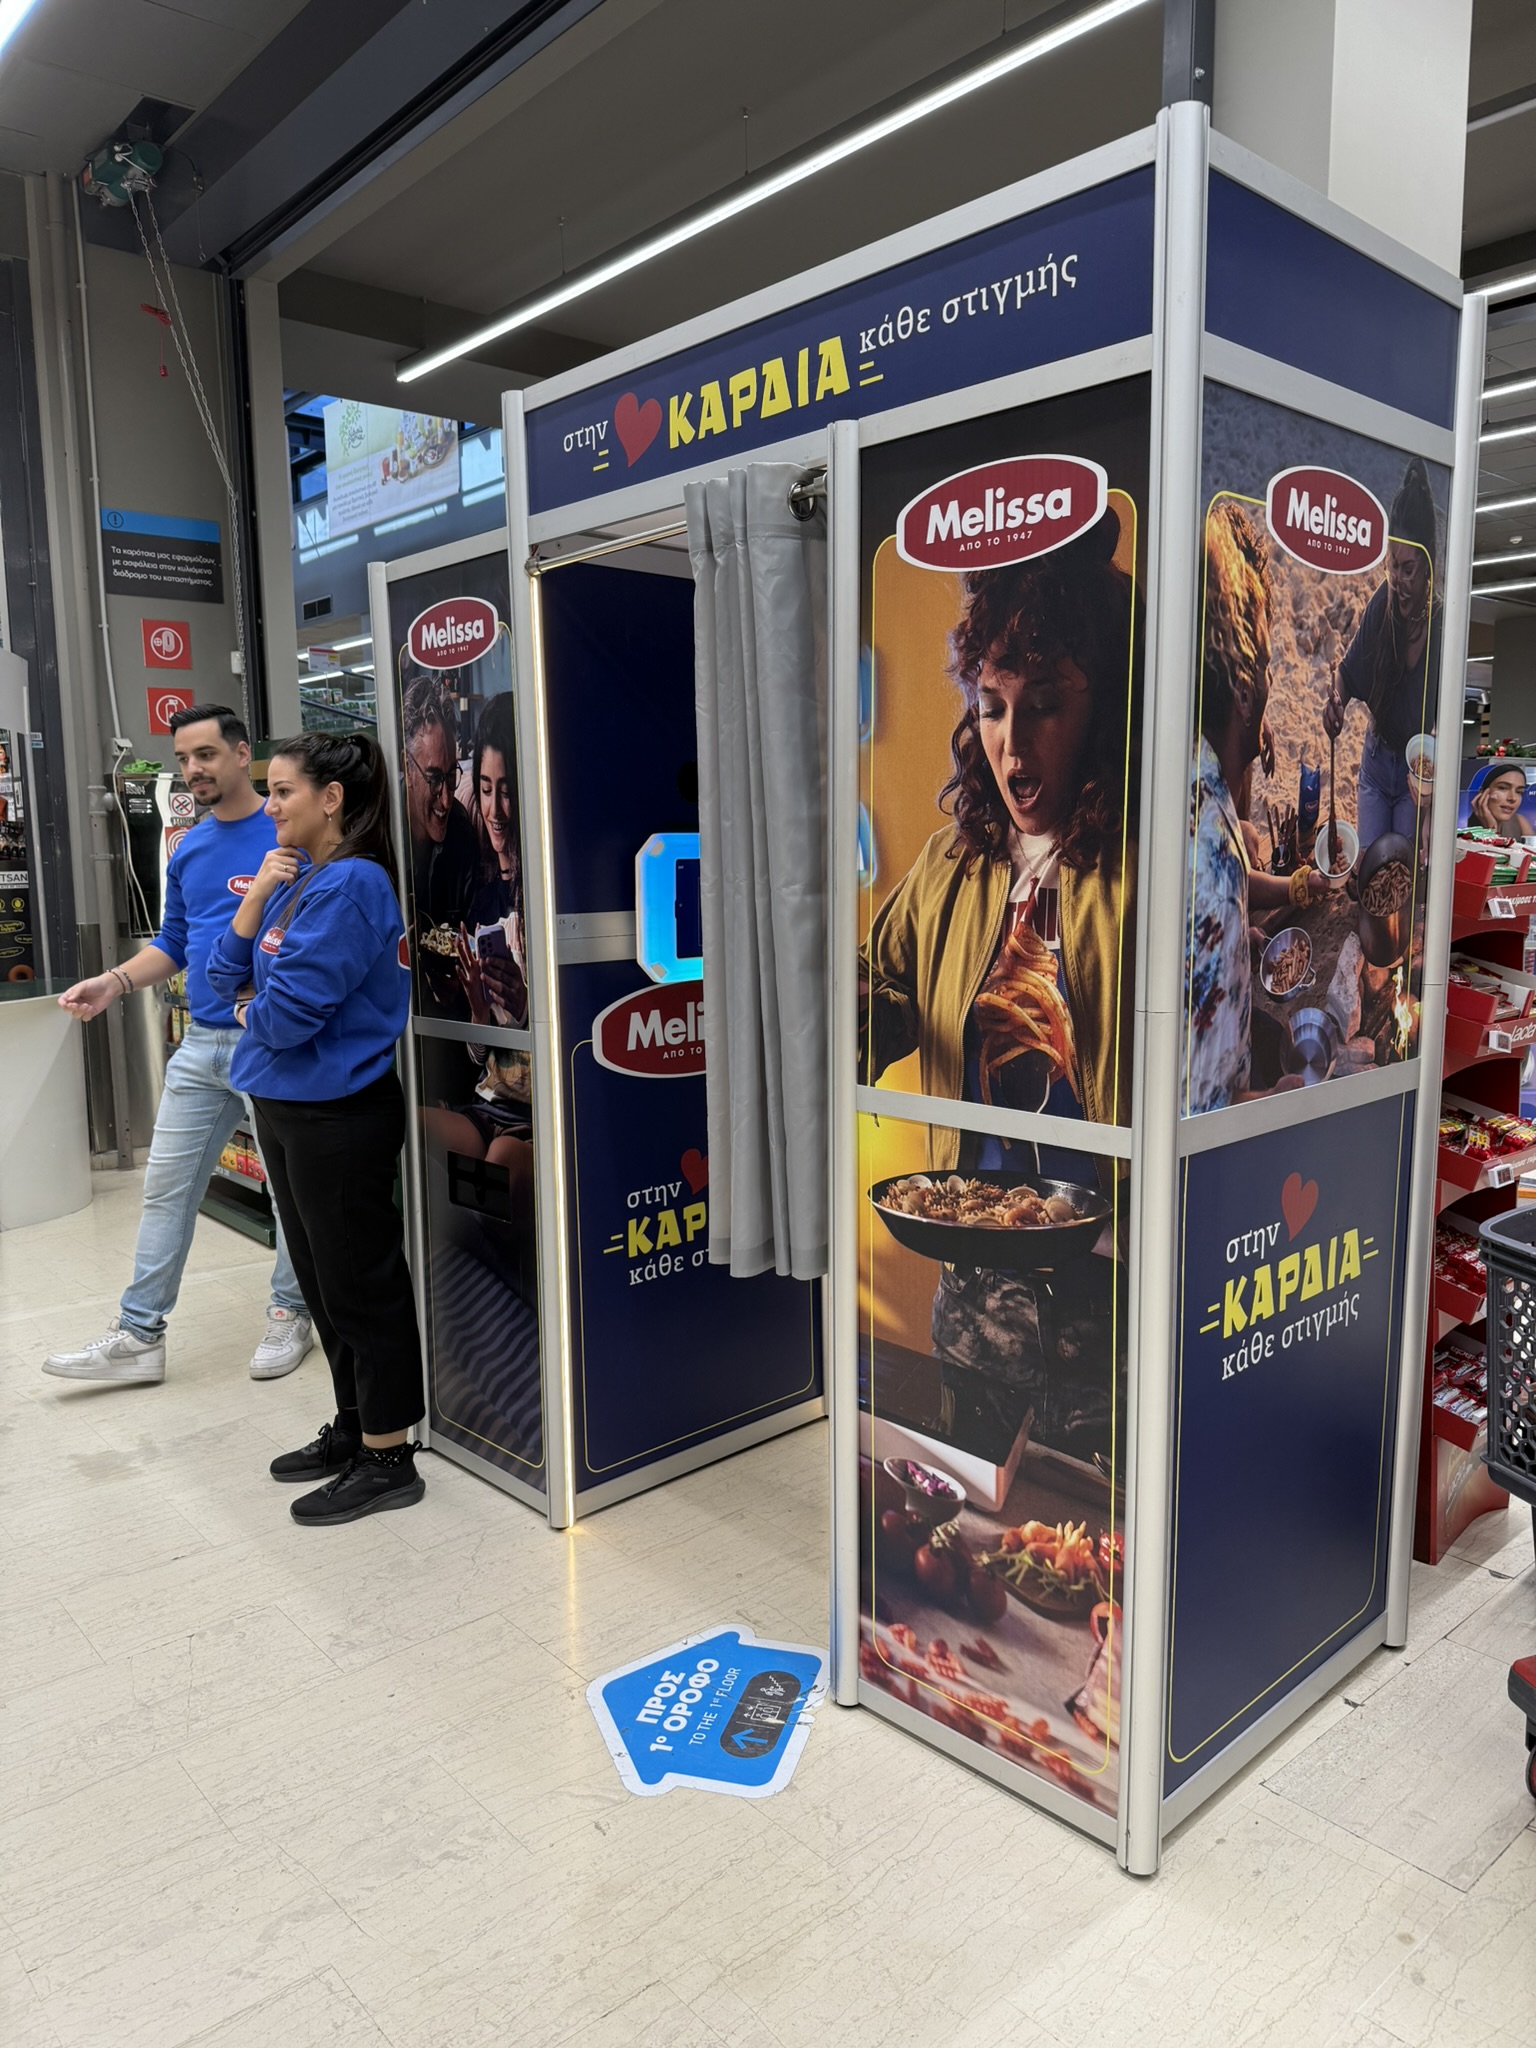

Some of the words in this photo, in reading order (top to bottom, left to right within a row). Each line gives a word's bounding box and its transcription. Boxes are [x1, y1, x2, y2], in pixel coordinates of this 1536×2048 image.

[563, 418, 609, 454] στην
[669, 335, 851, 449] ΚΑΡΔΙΑ
[859, 305, 932, 354] κάθε
[942, 253, 1078, 325] στιγμής
[926, 487, 1072, 545] Melissa
[1286, 487, 1372, 547] Melissa
[111, 546, 121, 554] Τα
[122, 548, 156, 558] καρότσια
[157, 552, 171, 560] μας
[959, 541, 982, 552] ΑΠΟ
[987, 536, 1001, 547] ΤΟ
[1007, 531, 1033, 543] 1947
[1335, 545, 1350, 556] 1947
[112, 569, 148, 579] διάδρομο
[149, 573, 162, 581] του
[122, 560, 158, 569] ασφάλεια
[421, 616, 485, 651] Melissa
[663, 1049, 685, 1059] ΑΠΟ
[690, 1046, 703, 1055] ΤΟ
[626, 1181, 682, 1208] στην
[1226, 1222, 1281, 1264] στην
[629, 1254, 684, 1286] κάθε
[1223, 1228, 1361, 1339] ΚΑΡΔΙΑ
[1221, 1331, 1275, 1381] κάθε
[1281, 1291, 1360, 1348] στιγμής
[635, 1670, 686, 1724] ΠΡΟΣ
[663, 1658, 720, 1732] ΟΡΟΦΟ
[715, 1667, 742, 1698] FLOOR
[689, 1727, 707, 1746] TO
[697, 1711, 718, 1732] THE
